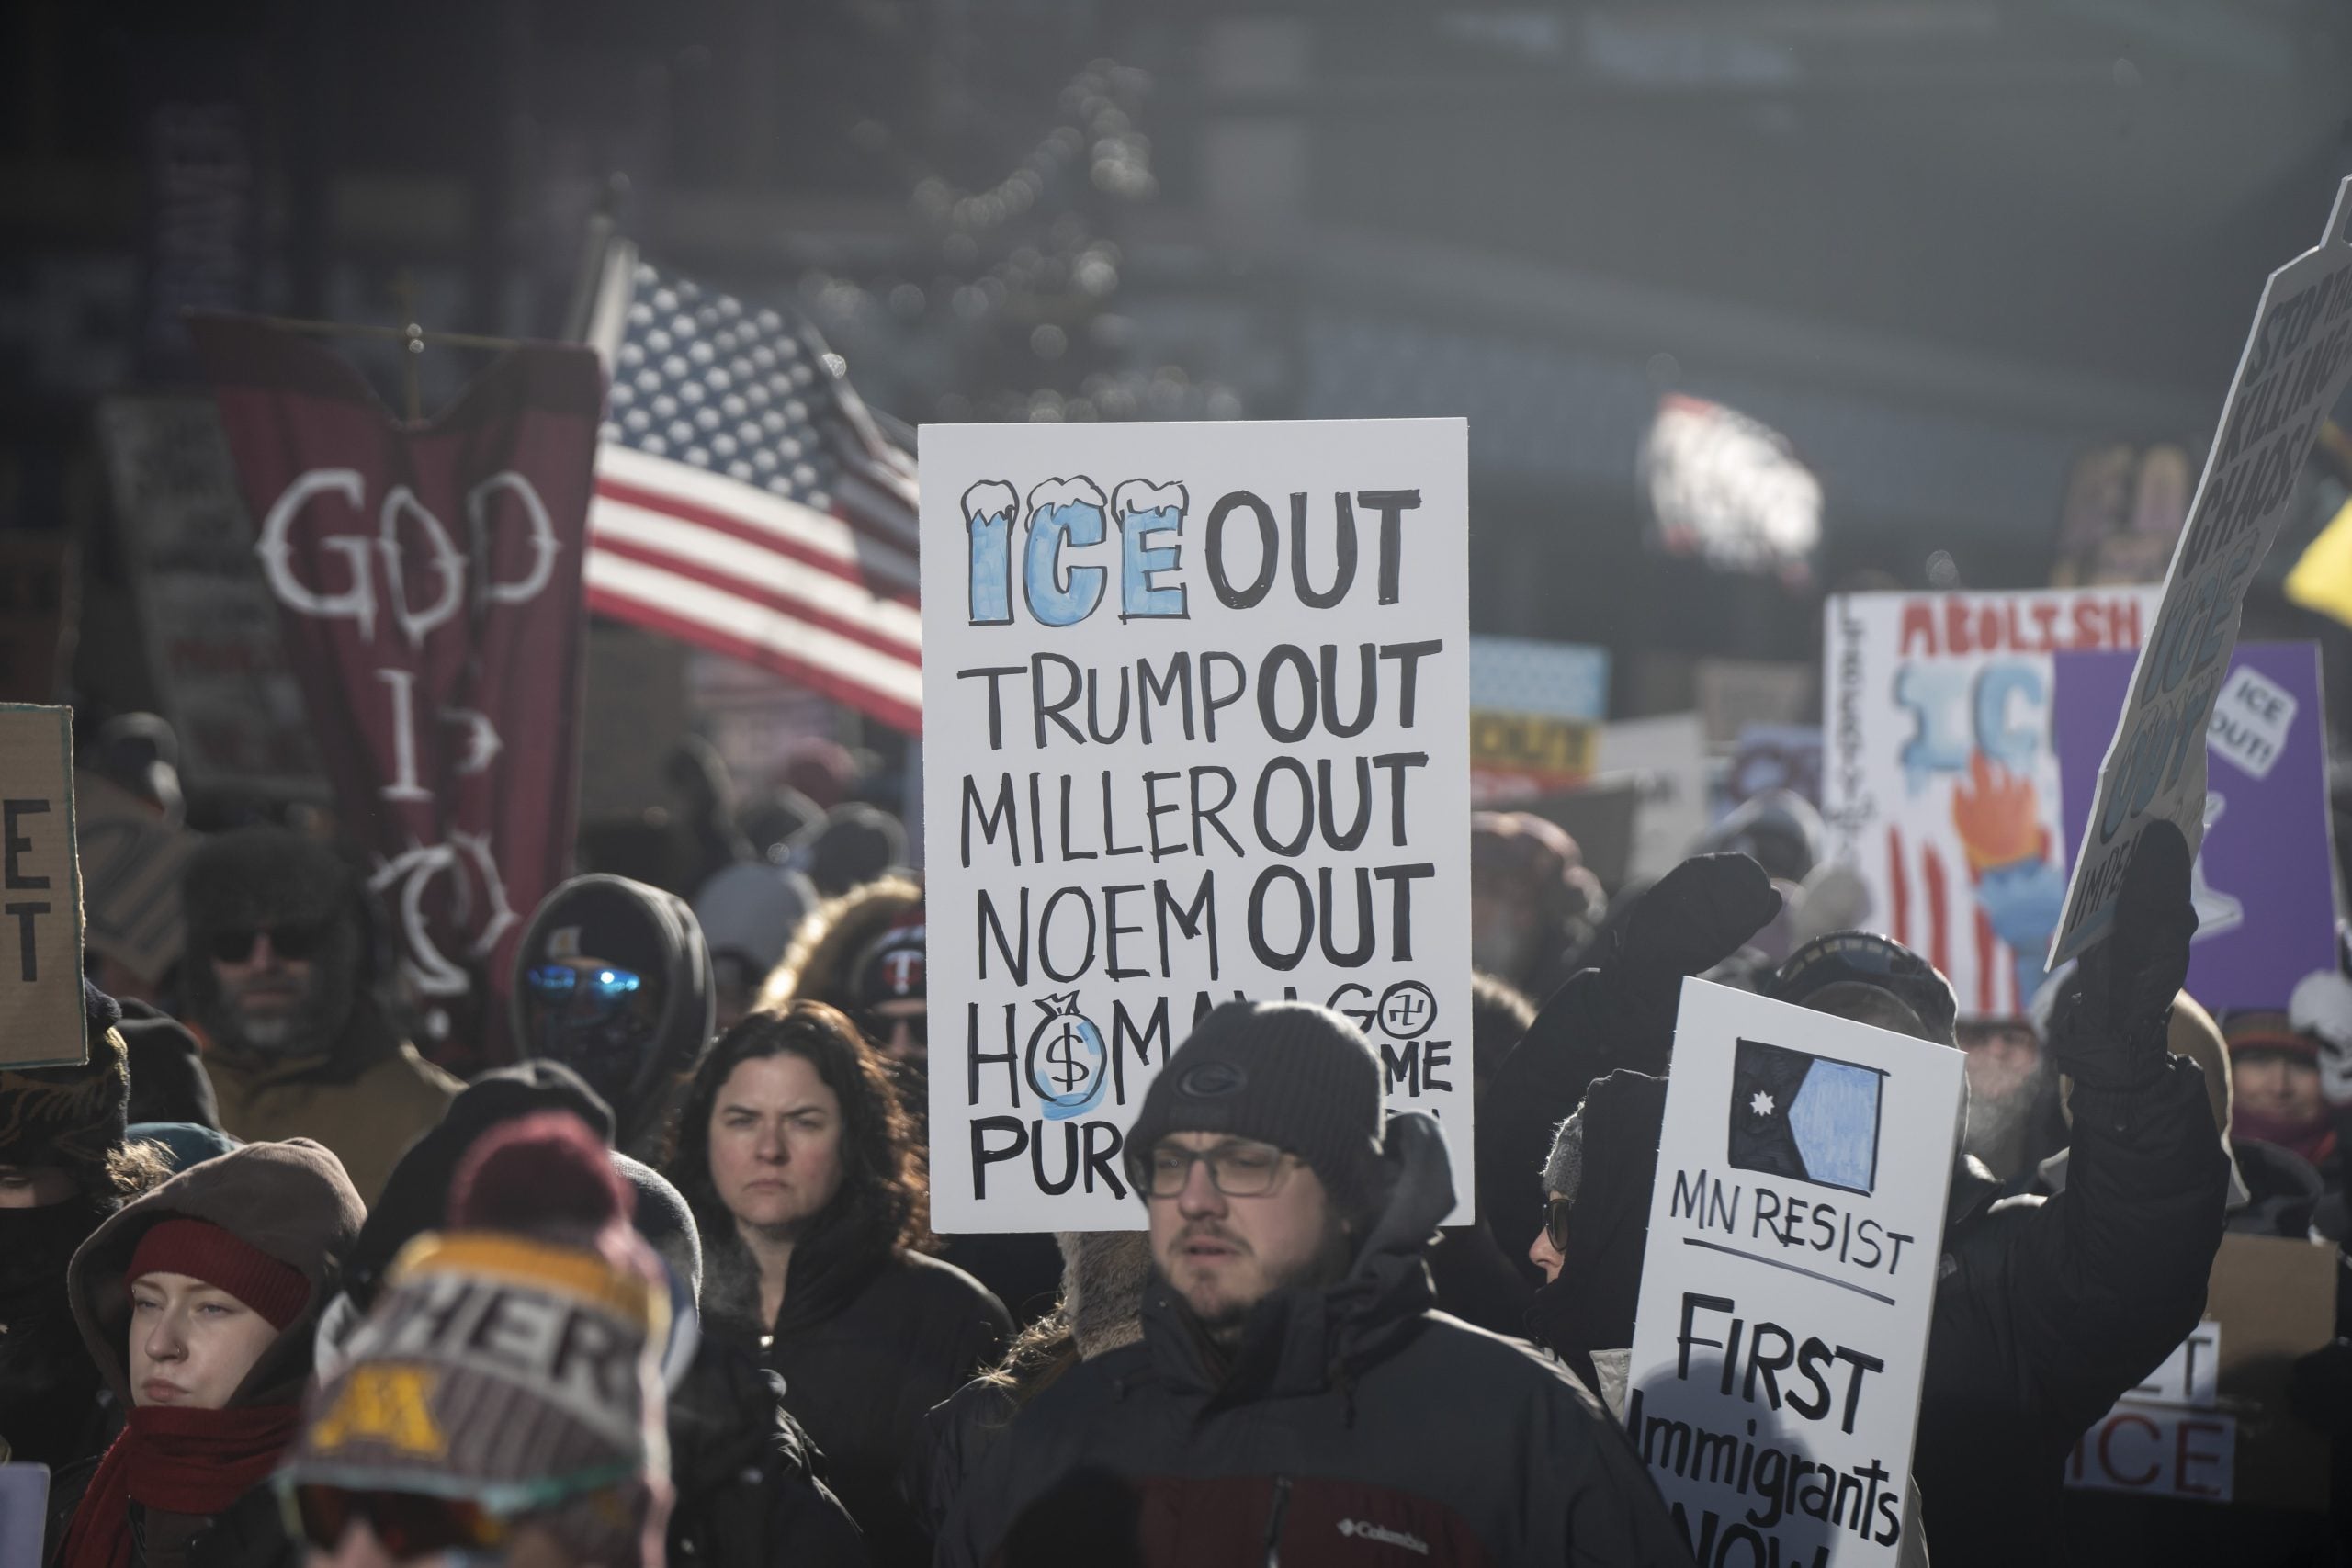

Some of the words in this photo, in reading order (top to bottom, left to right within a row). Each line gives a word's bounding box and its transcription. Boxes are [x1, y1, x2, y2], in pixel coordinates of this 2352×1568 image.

[2245, 272, 2335, 387] STOP
[2217, 318, 2351, 474] KILLING
[2183, 406, 2322, 578] CHAOS!
[255, 467, 557, 645] GOD
[961, 475, 1190, 627] ICE
[1205, 489, 1422, 610] OUT
[1898, 595, 2143, 659] ABOLISH
[2140, 526, 2259, 708] ICE
[957, 651, 1247, 750] TRUMP
[1257, 639, 1442, 745] OUT
[1891, 658, 2049, 773] IC
[2207, 710, 2275, 766] OUT!
[2233, 678, 2284, 724] ICE
[961, 765, 1245, 868] MILLER
[1253, 751, 1430, 858] OUT
[2100, 668, 2219, 844] OUT
[977, 869, 1219, 987] NOEM
[1247, 863, 1436, 971] OUT
[2069, 830, 2142, 933] IMPEA
[1381, 1040, 1453, 1098] ME
[1671, 1168, 1741, 1234] MN
[1752, 1188, 1915, 1275] RESIST
[1677, 1292, 1884, 1435] FIRST
[1628, 1388, 1900, 1547] Immigrants
[2072, 1412, 2224, 1495] ICE
